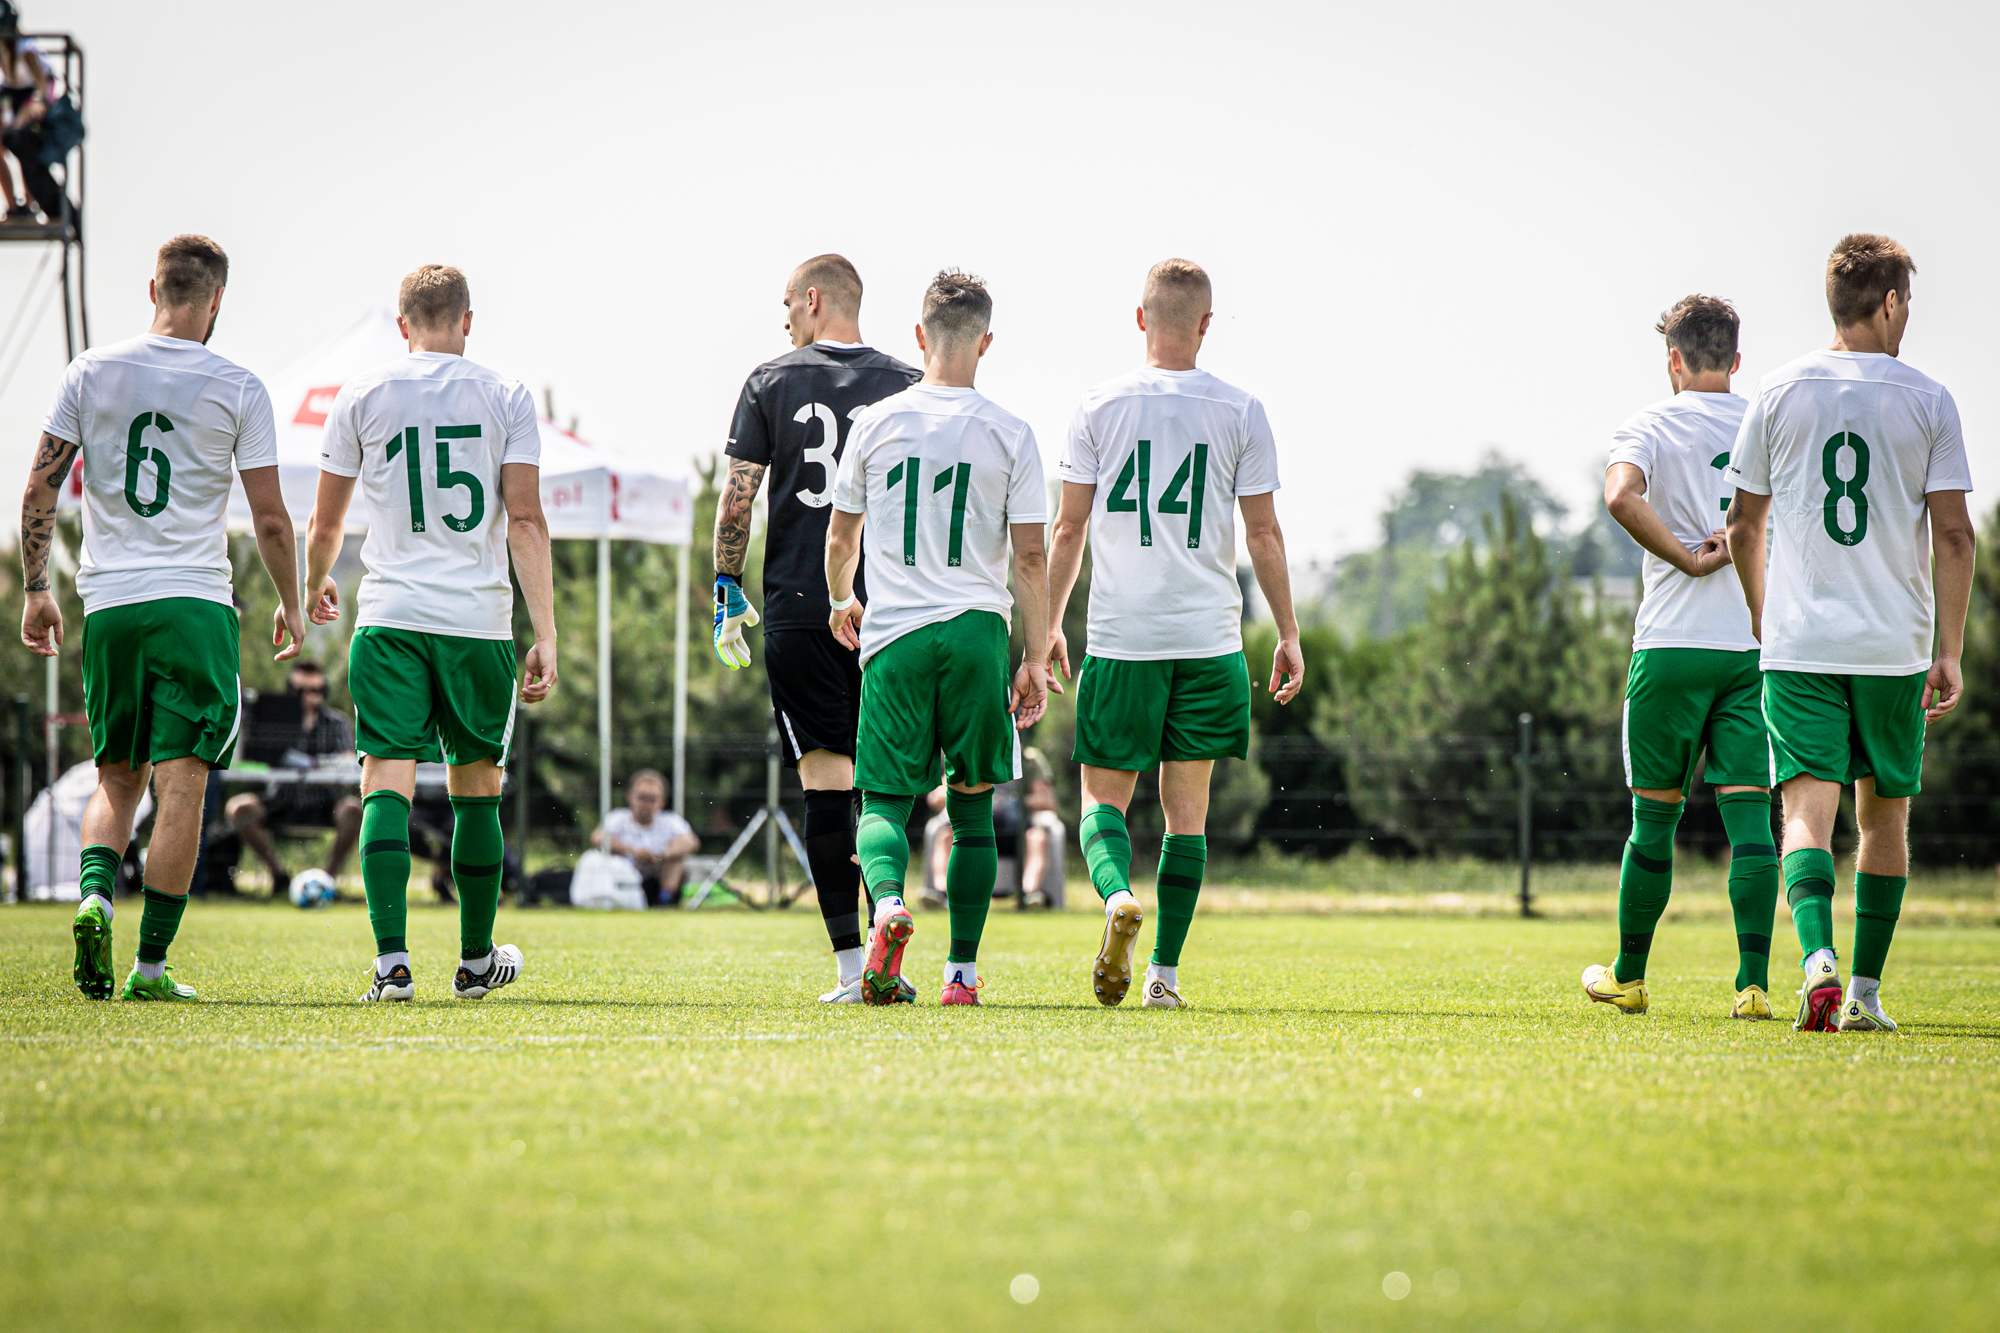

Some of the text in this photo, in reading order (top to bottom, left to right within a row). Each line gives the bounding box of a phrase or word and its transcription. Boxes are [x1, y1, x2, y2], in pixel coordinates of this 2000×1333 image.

[124, 411, 174, 517] 6
[386, 424, 484, 532] 15
[887, 456, 971, 566] 11
[1107, 439, 1208, 548] 44
[1822, 431, 1870, 546] 8
